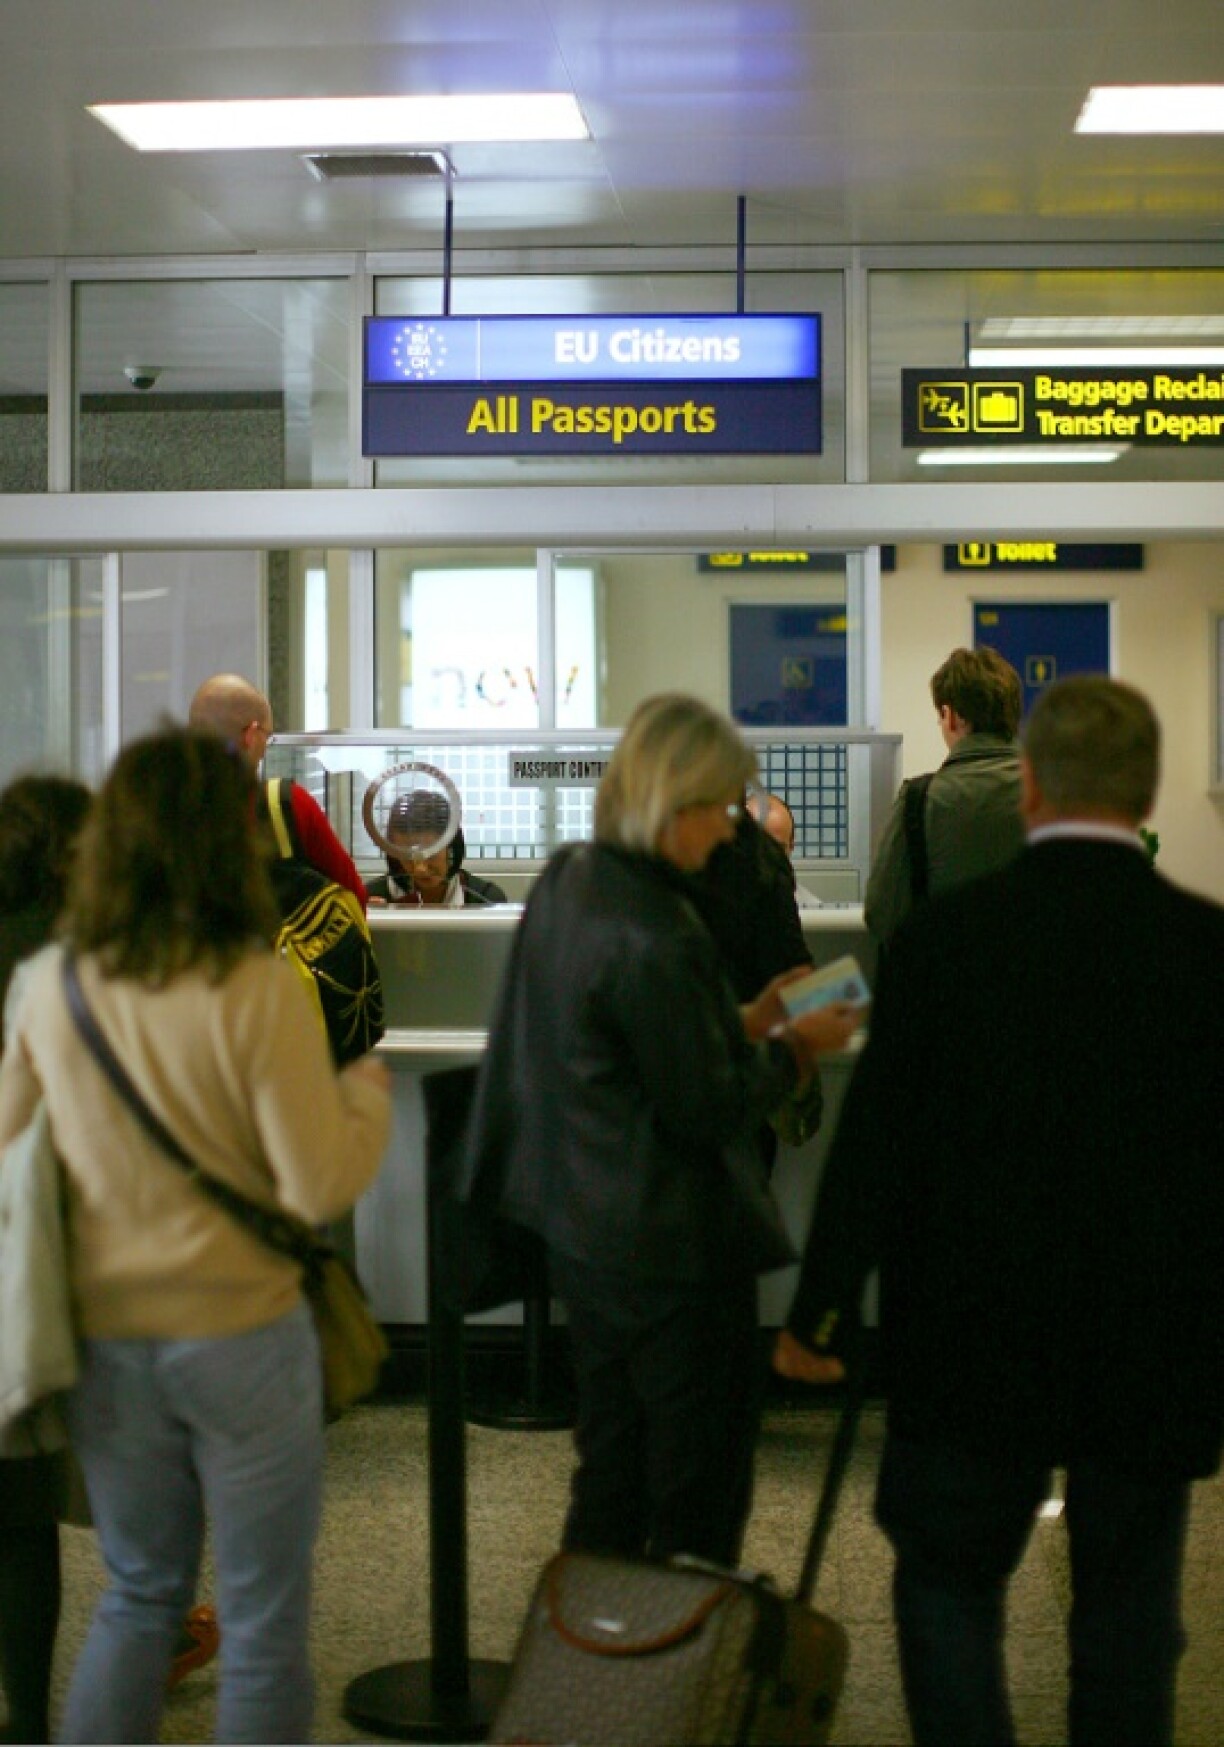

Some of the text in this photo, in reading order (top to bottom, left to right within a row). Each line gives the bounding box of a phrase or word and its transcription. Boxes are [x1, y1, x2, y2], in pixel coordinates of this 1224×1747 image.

[554, 328, 741, 363] EU Citizens
[1035, 375, 1148, 406] Baggage
[466, 395, 716, 443] All Passports
[1035, 407, 1224, 442] Transfer Depar
[513, 761, 567, 779] PASSPORT
